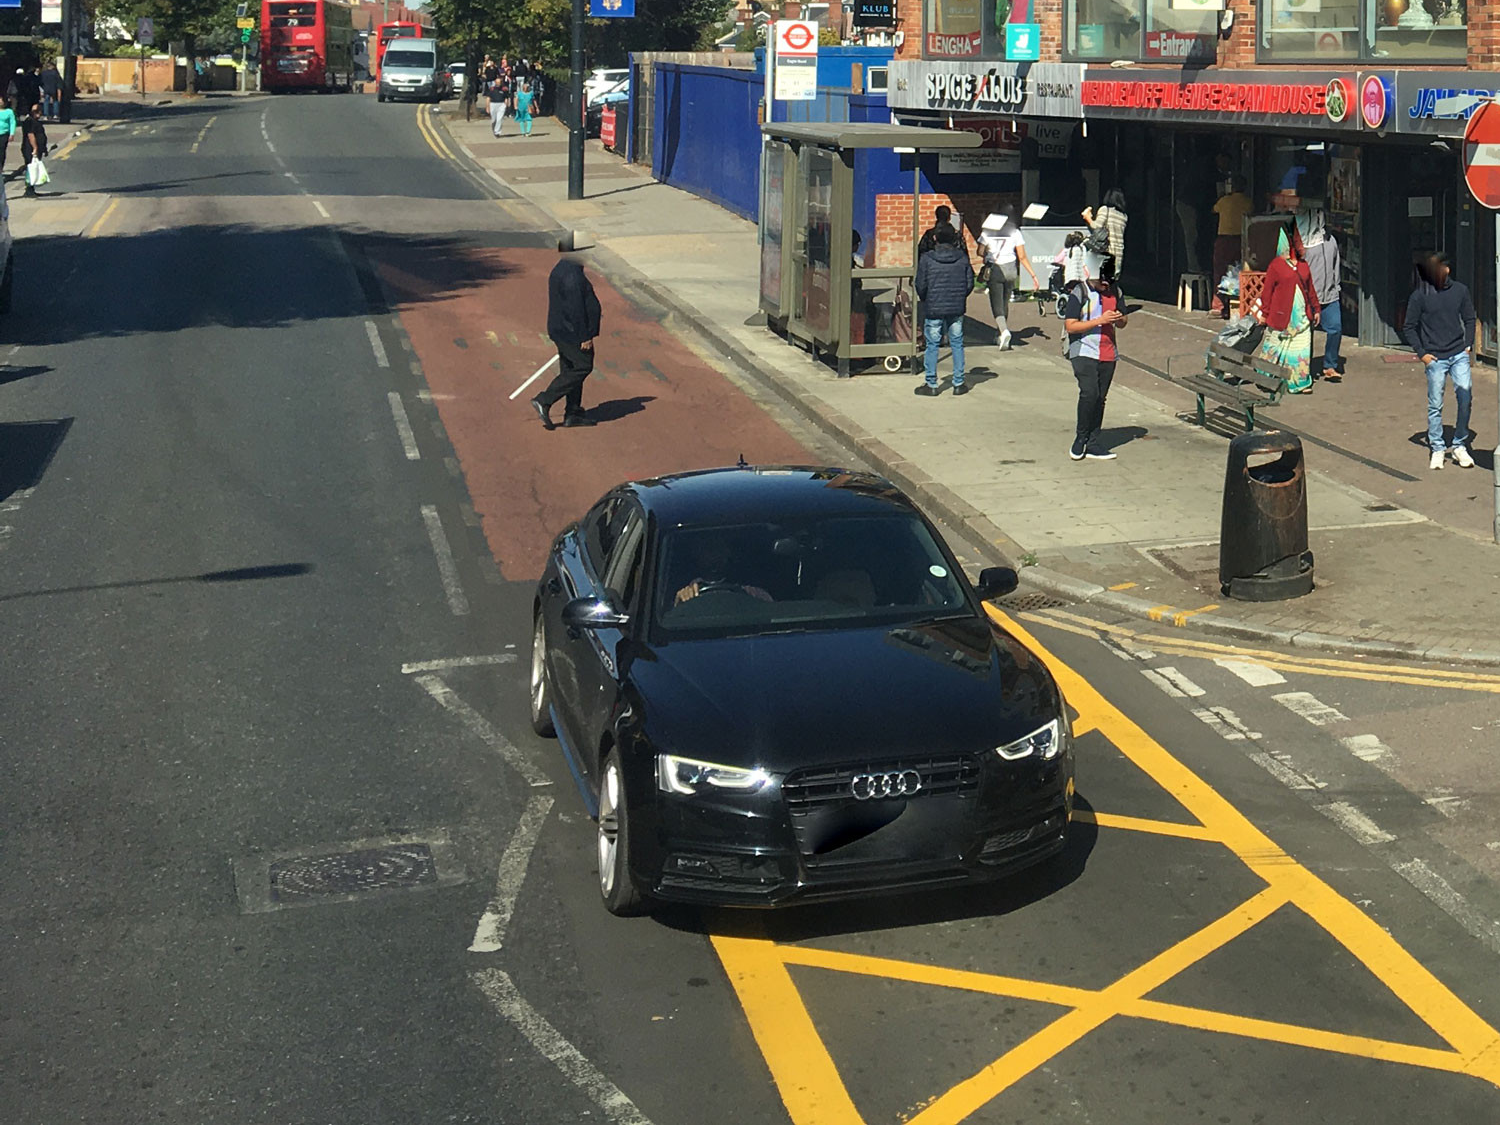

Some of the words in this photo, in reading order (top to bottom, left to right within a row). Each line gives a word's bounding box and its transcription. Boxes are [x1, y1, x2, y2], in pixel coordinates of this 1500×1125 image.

[862, 5, 889, 13] KLUB
[929, 35, 972, 55] LENGHA
[926, 72, 972, 100] SPICE
[974, 73, 1023, 105] KLUB
[1082, 81, 1136, 107] WEMBLEY
[1135, 82, 1161, 108] OFF
[1161, 82, 1218, 111] LICENCE
[1221, 83, 1230, 111] &
[1236, 85, 1269, 113] PAN
[1271, 85, 1324, 115] HOUSE
[1036, 123, 1060, 139] live
